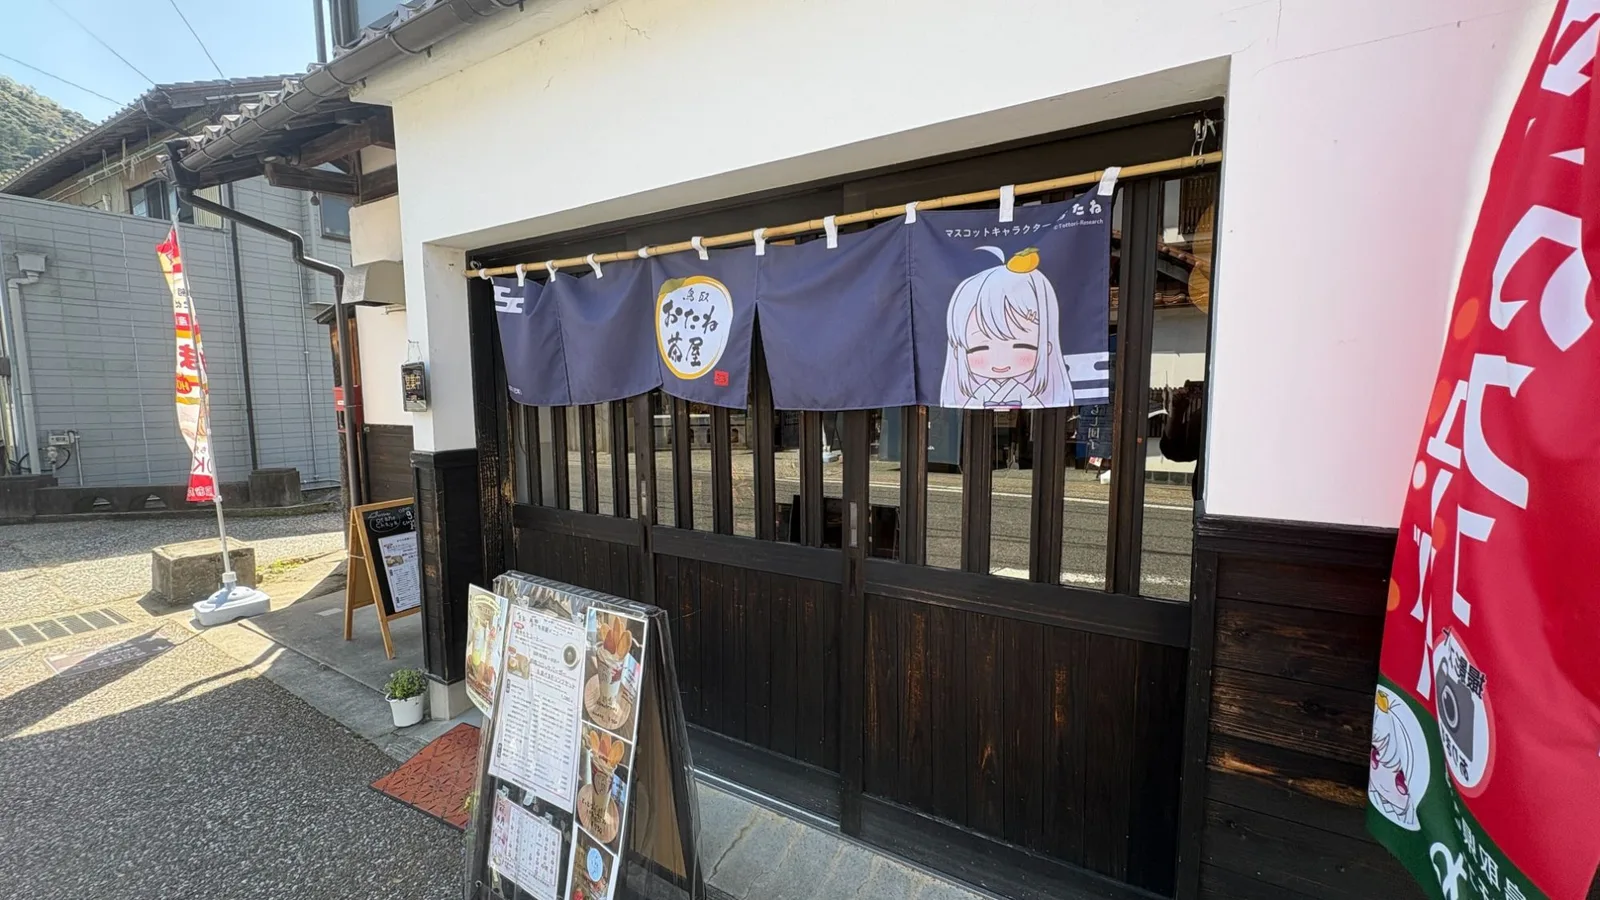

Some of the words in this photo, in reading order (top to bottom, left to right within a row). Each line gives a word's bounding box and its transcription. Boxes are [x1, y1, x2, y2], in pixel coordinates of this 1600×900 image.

[945, 222, 1052, 239] マスコットキャラクター
[662, 299, 719, 334] おたね
[667, 331, 704, 367] 茶屋
